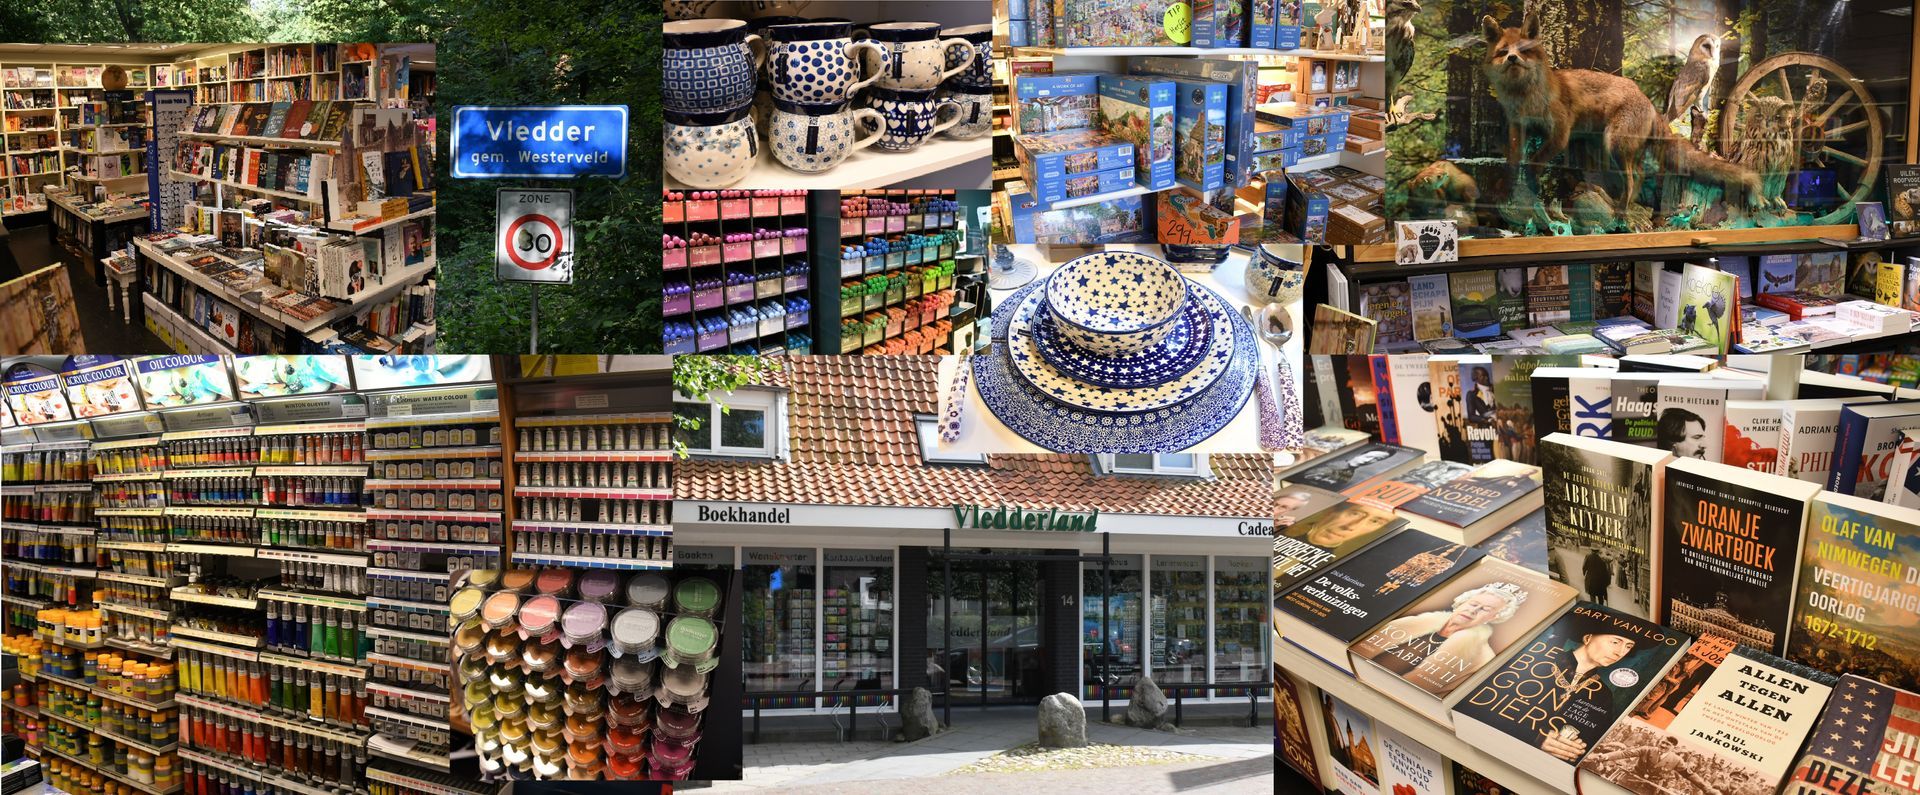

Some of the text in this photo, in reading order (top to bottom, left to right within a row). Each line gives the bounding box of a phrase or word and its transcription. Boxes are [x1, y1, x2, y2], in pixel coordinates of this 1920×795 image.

[1167, 4, 1181, 17] TIP
[486, 119, 596, 142] Vledder
[471, 150, 608, 166] gem. Westerveld
[519, 194, 551, 204] ZONE
[518, 228, 552, 252] 30
[1412, 281, 1435, 291] LAND
[149, 355, 205, 371] OIL COLOUR
[28, 380, 57, 392] COLOUR
[66, 366, 124, 386] ACRYLIC COLOUR
[1664, 395, 1684, 403] CHRIS
[1628, 427, 1654, 437] RUUD
[1798, 425, 1828, 434] ADRIAN
[1563, 471, 1570, 480] DE
[1430, 487, 1493, 509] NOBEL
[1449, 482, 1502, 498] ALFRED
[1564, 482, 1628, 517] ABRAHAM
[1696, 486, 1716, 496] SPIONAGE
[1738, 496, 1762, 508] CORRUPTIE
[698, 505, 791, 524] Boekhandel
[953, 503, 1099, 532] Vledderland
[1569, 506, 1622, 540] KUYPER
[1697, 499, 1761, 540] ORANJE
[1821, 514, 1896, 550] OLAF VAN
[1680, 521, 1777, 572] ZWARTBOEK
[1283, 563, 1312, 578] HET
[1681, 548, 1773, 582] DE ONTLUISTERENDE GESCHIEDENIS
[1684, 556, 1767, 588] VAN ONZE KONINKLIJKE FAMILIE
[1816, 541, 1902, 580] NIMWEGEN
[1314, 576, 1360, 600] De volks-
[1060, 595, 1074, 606] 14
[1302, 584, 1368, 618] verhuizingen
[1809, 591, 1866, 623] OORLOG
[1574, 606, 1678, 646] BART VAN LOO
[1806, 615, 1877, 651] 1672-1712
[1366, 635, 1457, 683] ELIZABETH II
[1380, 623, 1472, 673] KONINGIN
[1528, 641, 1565, 660] DE
[1711, 642, 1725, 653] MY
[1509, 653, 1603, 700] BOUR
[1737, 664, 1810, 695] ALLEN
[1492, 670, 1570, 712] GON
[1739, 680, 1791, 704] TEGEN
[1468, 685, 1568, 738] DIËRS
[1567, 706, 1589, 718] LAGE
[1718, 689, 1793, 722] ALLEN
[1562, 711, 1597, 729] LANDEN
[1690, 729, 1764, 762] JANKOWSKI
[1716, 729, 1747, 746] PAUL
[1383, 740, 1393, 751] DE
[1394, 746, 1434, 778] GENIALE
[1388, 751, 1430, 783] EENVOUD
[1390, 760, 1431, 792] VAN TAAL
